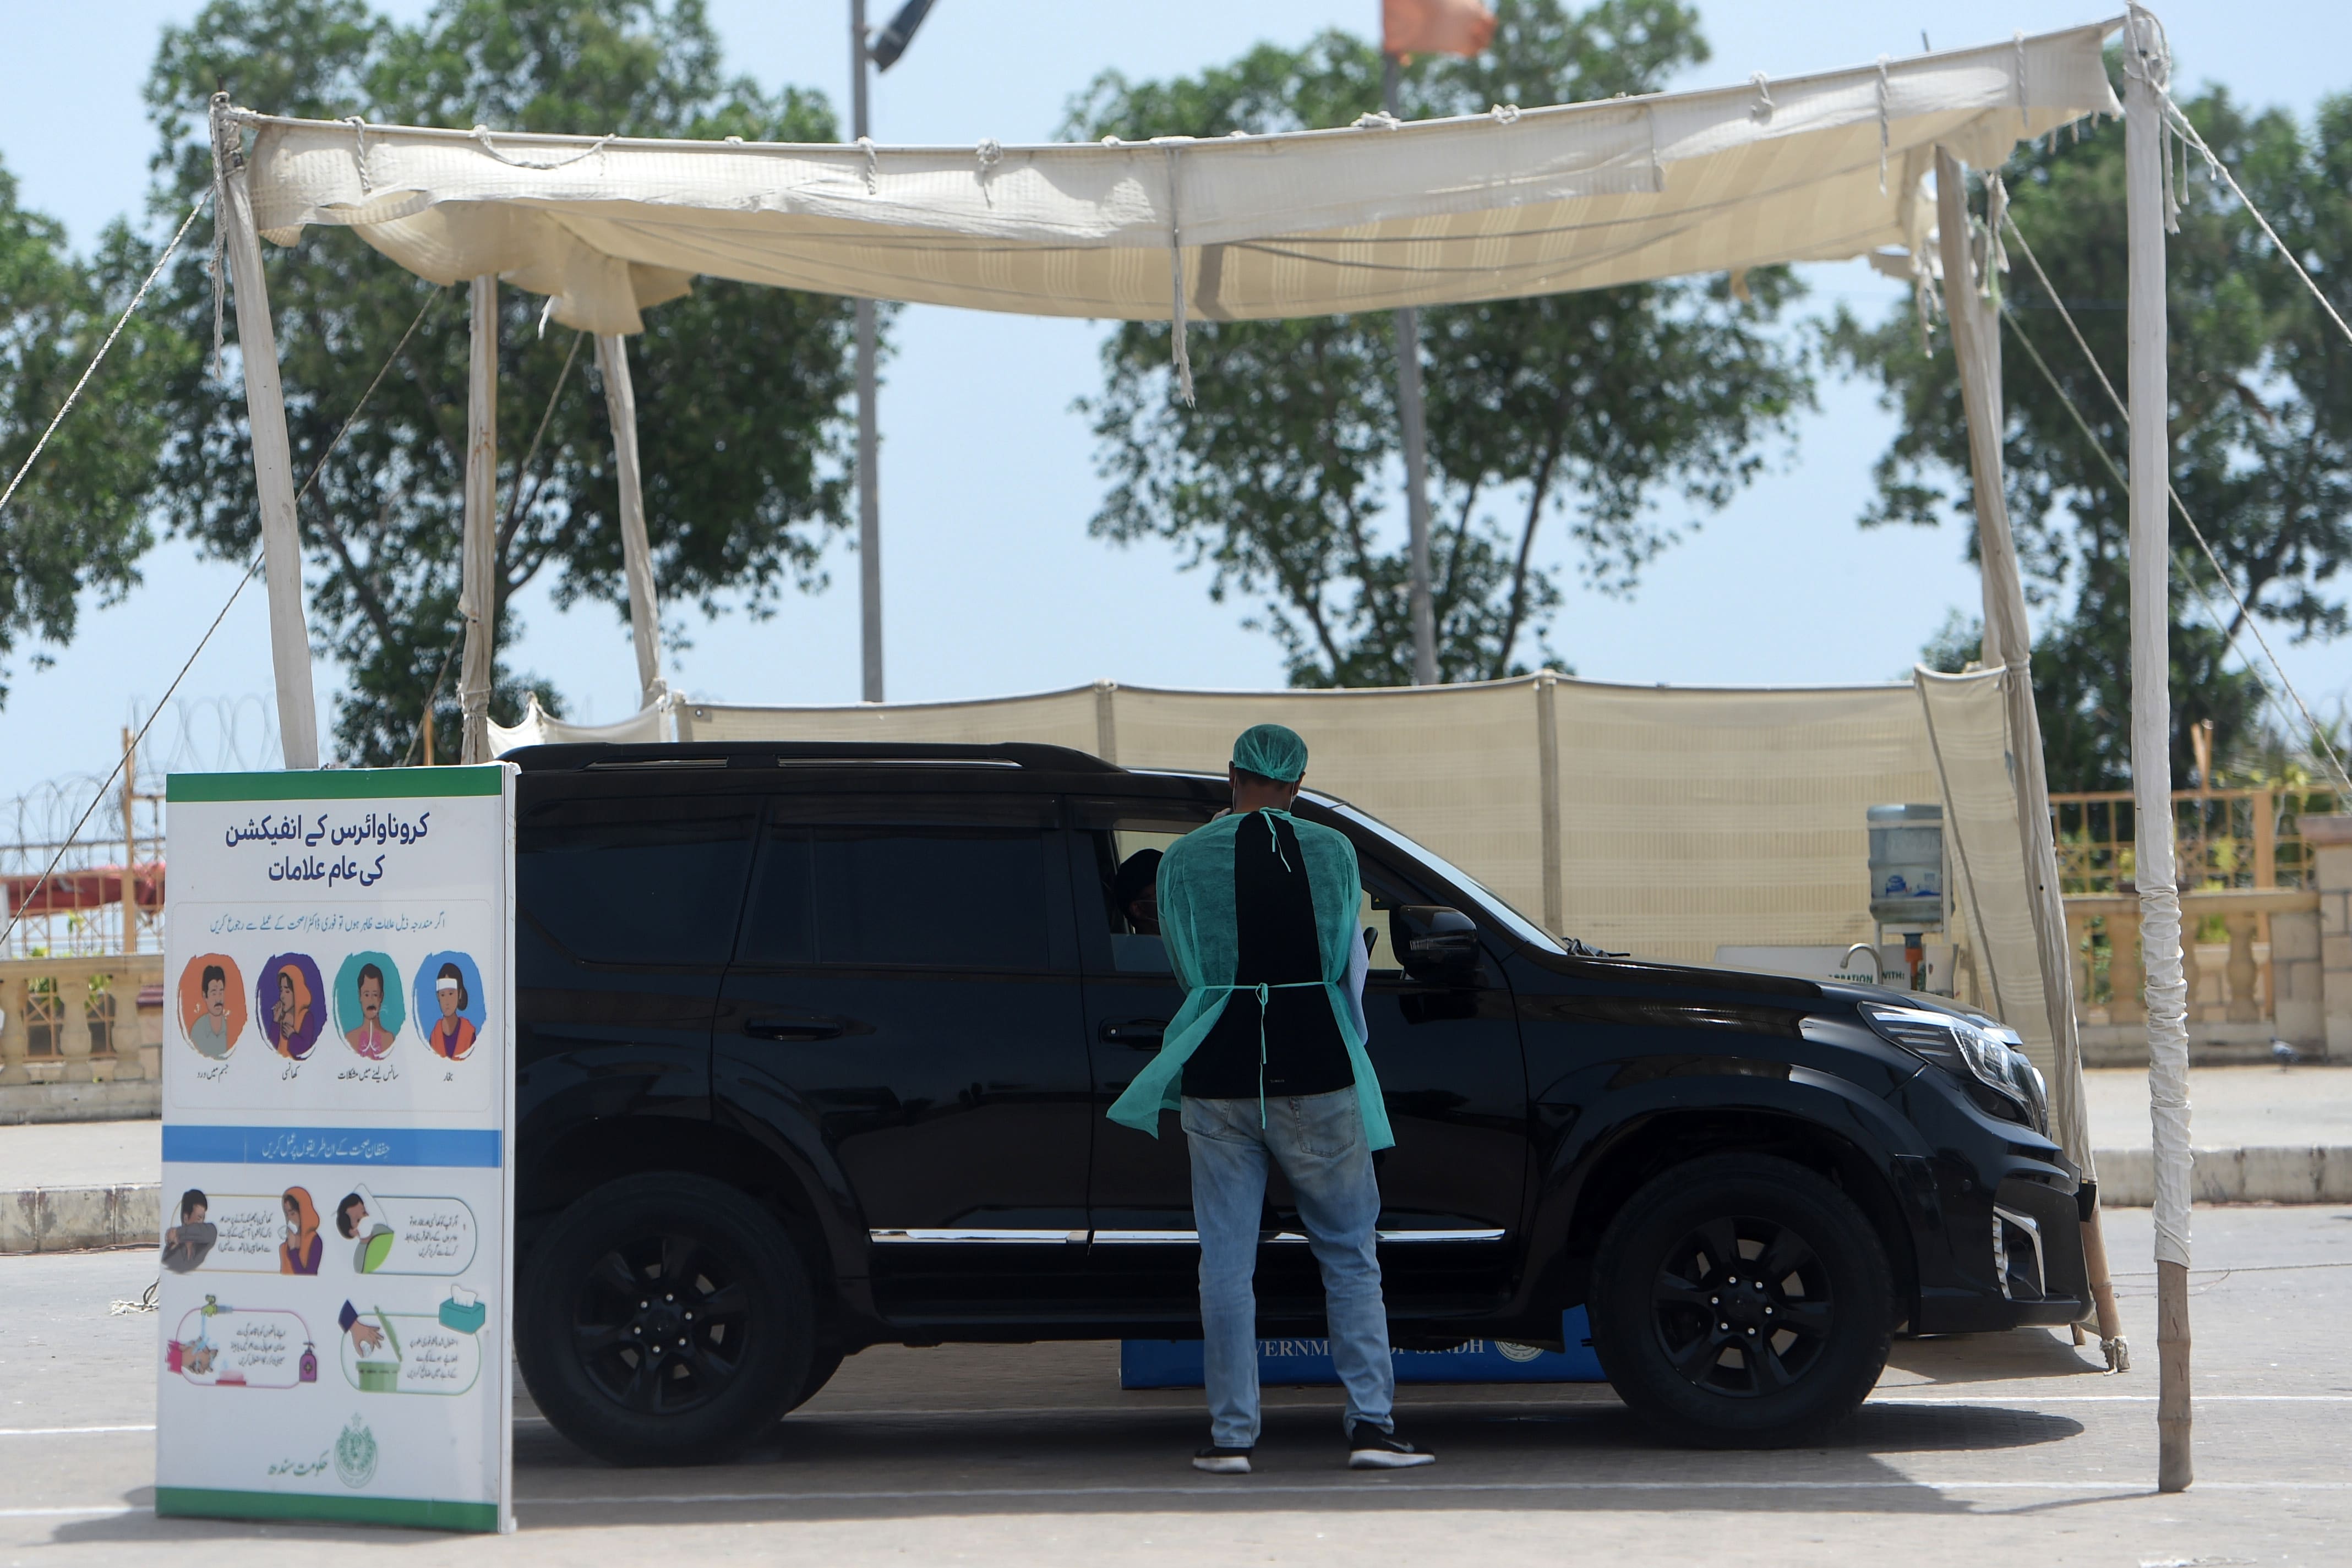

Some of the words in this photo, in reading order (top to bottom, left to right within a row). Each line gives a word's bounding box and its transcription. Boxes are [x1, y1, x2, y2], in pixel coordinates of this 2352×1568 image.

[225, 815, 302, 848] انفیکشن
[305, 813, 329, 848] کے
[268, 855, 325, 882] علامات
[329, 855, 357, 888] عام
[359, 855, 385, 887] کی
[210, 913, 229, 935] کریں
[227, 916, 244, 933] رجوع
[246, 922, 258, 931] سے
[260, 914, 272, 931] عملے
[274, 914, 285, 931] کے
[322, 914, 336, 932] فوری
[339, 915, 344, 930] تو
[345, 920, 359, 932] ہوں
[359, 917, 373, 933] ظاہر
[375, 917, 394, 930] علامات
[395, 913, 408, 932] ذیل
[411, 920, 433, 933] مندرجہ
[434, 911, 445, 930] اگر
[206, 1068, 219, 1080] میں
[219, 1064, 229, 1084] جسم
[282, 1062, 301, 1081] کھانسی
[338, 1067, 359, 1080] مشکلات
[359, 1068, 370, 1082] میں
[371, 1066, 382, 1084] لینے
[384, 1064, 399, 1082] سانس
[444, 1071, 454, 1082] بخار
[262, 1134, 285, 1159] کریں
[325, 1143, 335, 1159] ان
[336, 1137, 349, 1156] کے
[1256, 1340, 1330, 1357] VERNM
[268, 1458, 294, 1476] سندھ
[293, 1449, 330, 1477] حکومت
